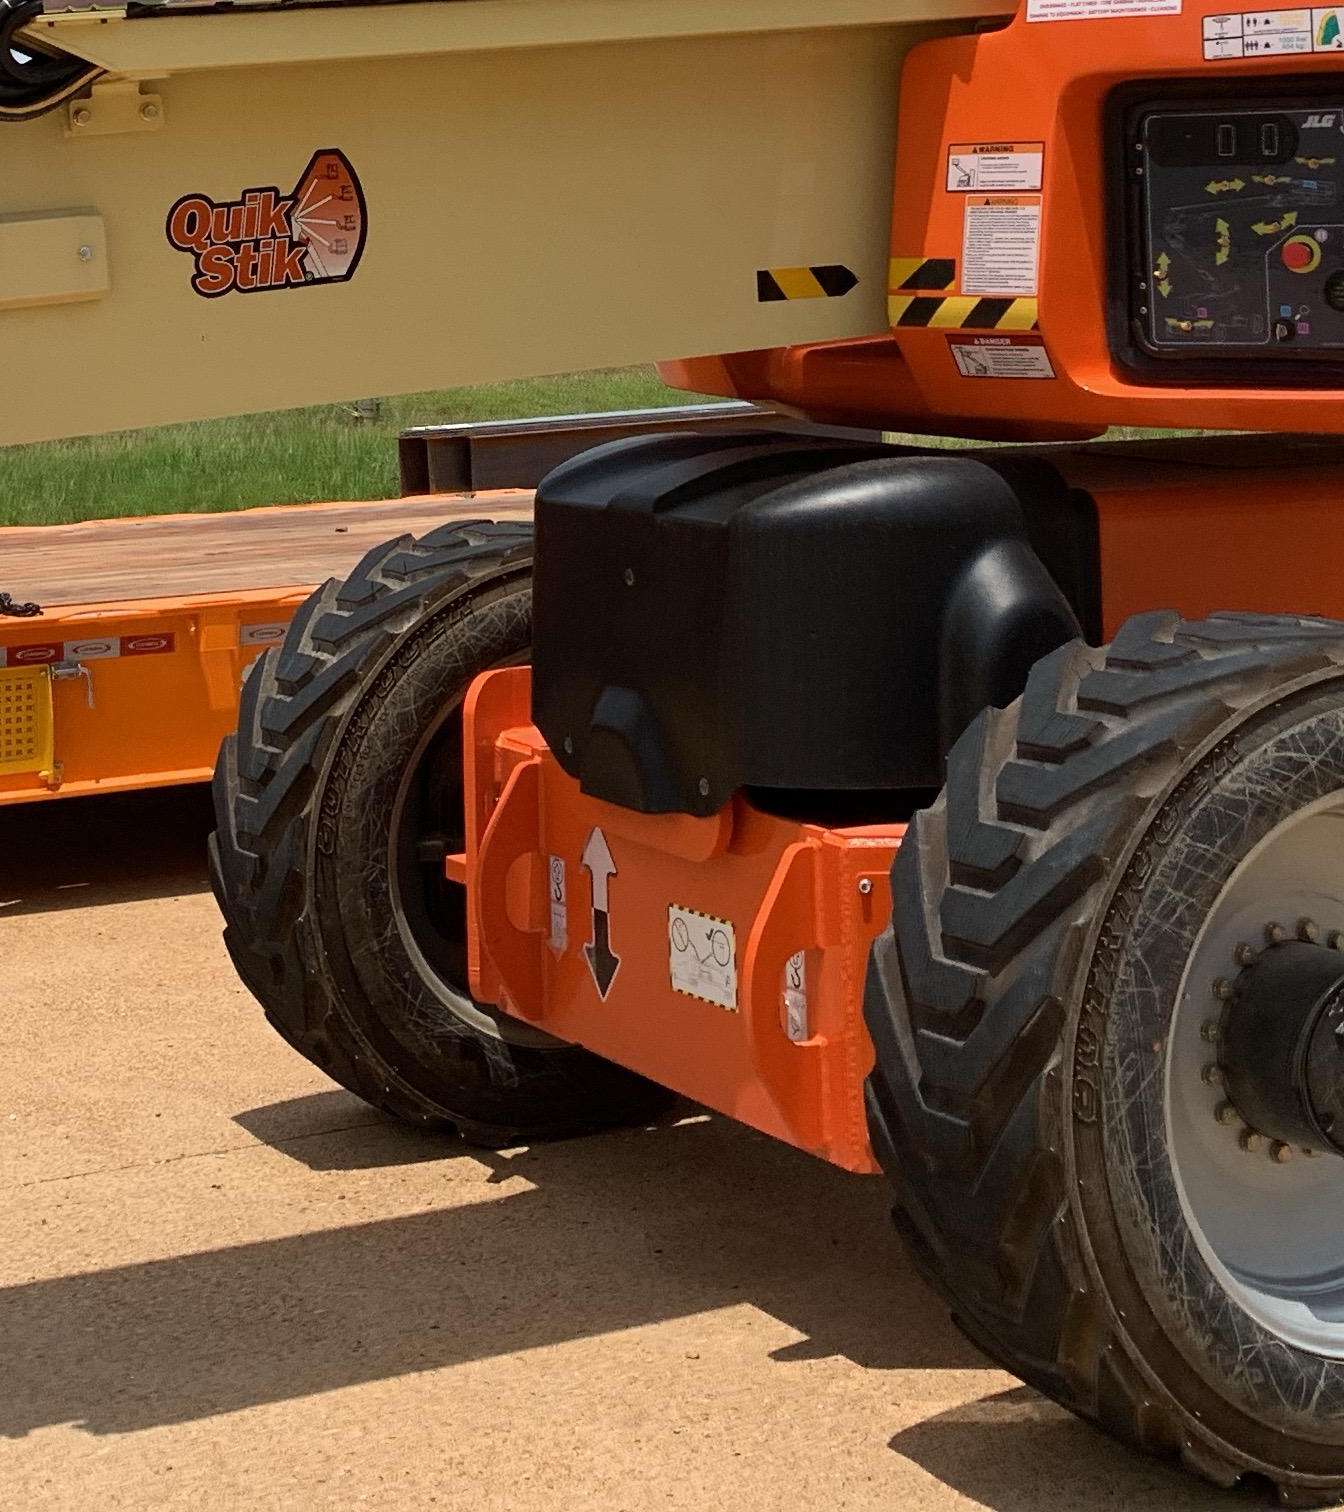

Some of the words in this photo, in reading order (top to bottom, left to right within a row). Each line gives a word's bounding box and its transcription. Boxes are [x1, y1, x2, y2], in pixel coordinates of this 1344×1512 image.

[1301, 114, 1336, 128] JLG
[978, 145, 1015, 154] WARNING
[169, 191, 296, 252] Quik
[195, 238, 306, 294] Stik
